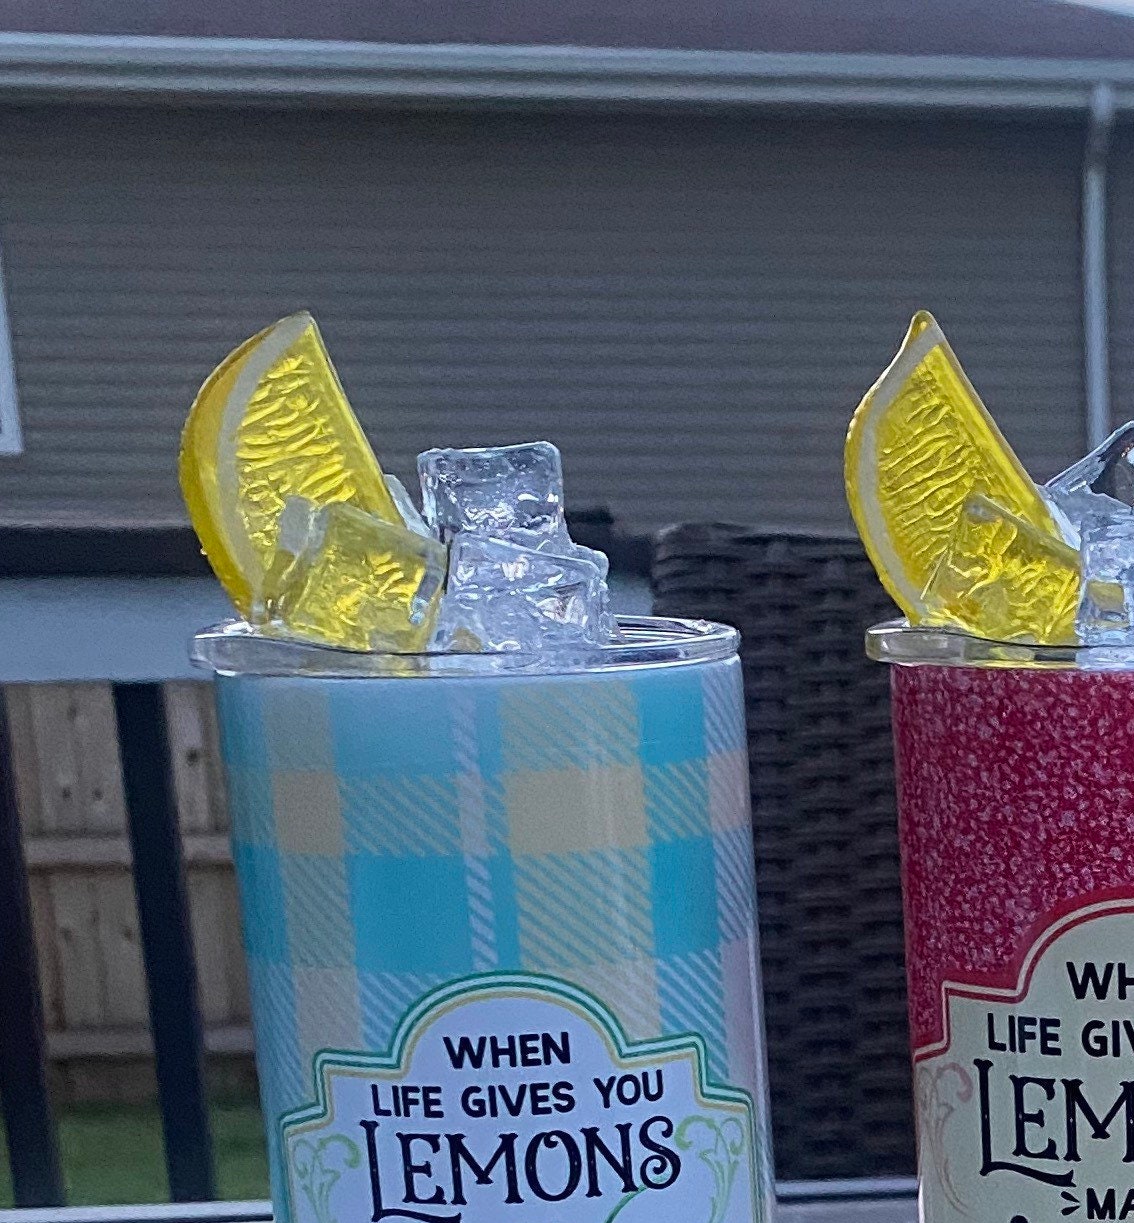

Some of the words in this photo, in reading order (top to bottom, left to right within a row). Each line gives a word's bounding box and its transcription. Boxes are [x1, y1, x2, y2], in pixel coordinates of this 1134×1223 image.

[443, 1031, 571, 1069] WHEN
[987, 1012, 1062, 1056] LIFE
[371, 1083, 444, 1119] LIFE
[460, 1081, 575, 1119] GIVES
[593, 1069, 664, 1109] YOU
